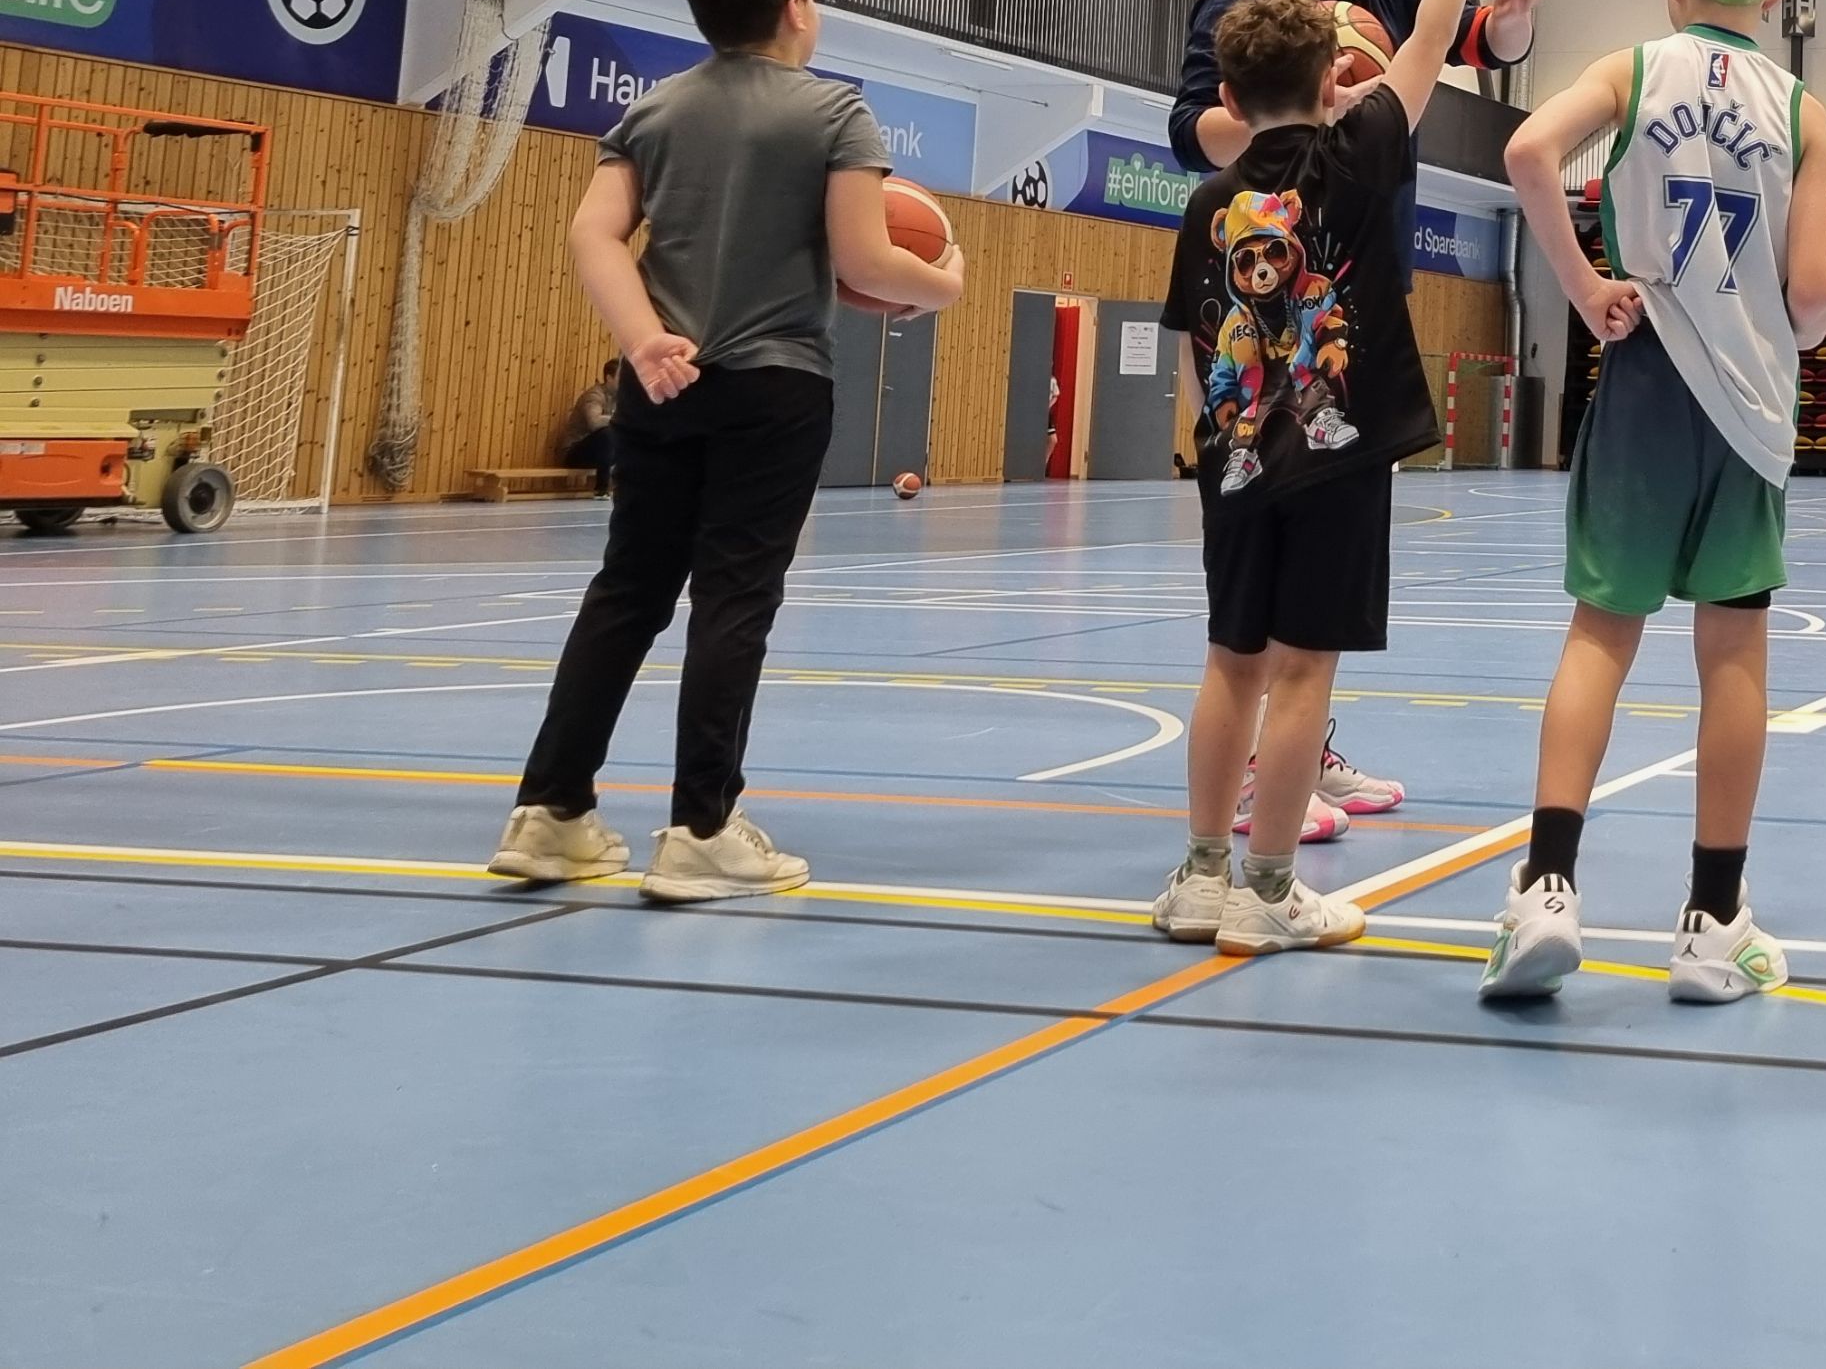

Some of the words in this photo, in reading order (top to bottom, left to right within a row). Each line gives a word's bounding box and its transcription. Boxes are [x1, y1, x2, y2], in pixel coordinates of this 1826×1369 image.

[1424, 227, 1481, 260] Sparebank
[1663, 174, 1761, 295] 77
[53, 286, 134, 313] Naboen
